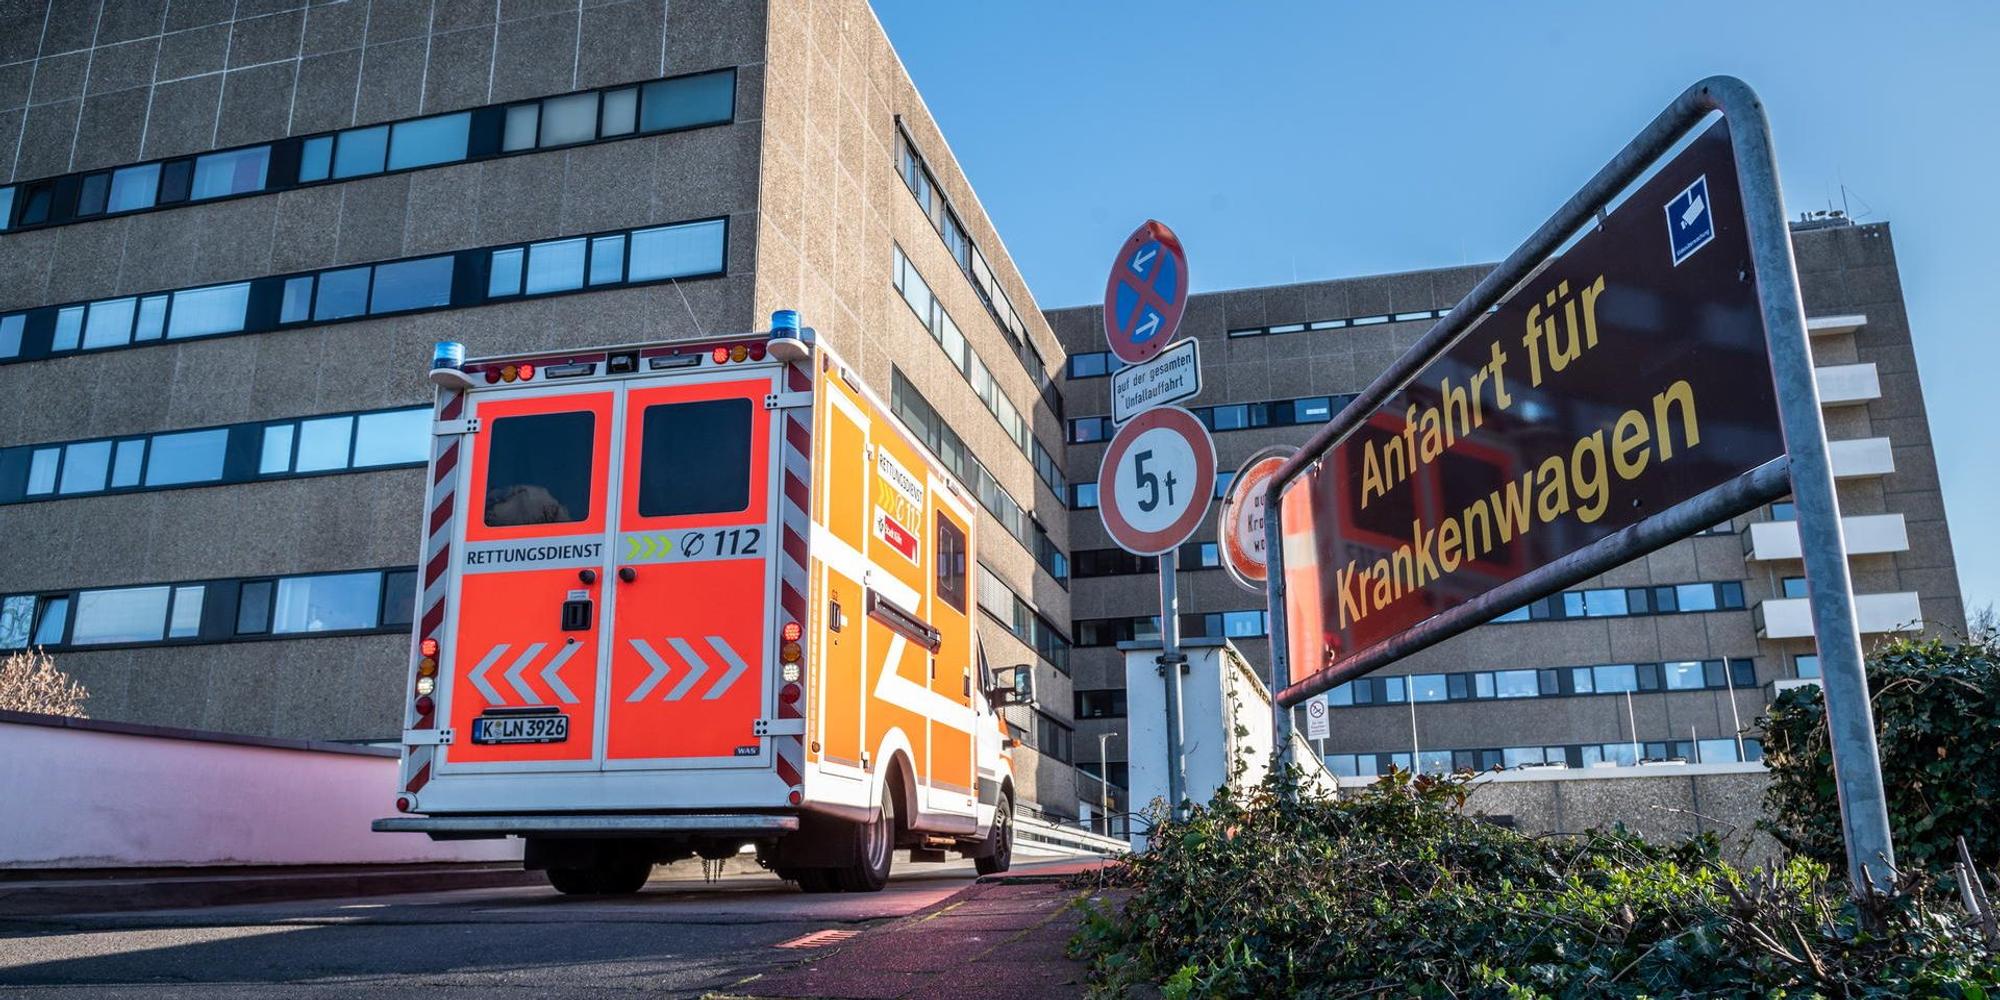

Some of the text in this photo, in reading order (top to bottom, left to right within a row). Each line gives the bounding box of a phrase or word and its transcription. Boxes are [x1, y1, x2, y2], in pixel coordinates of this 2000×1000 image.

[1116, 353, 1191, 394] auf der gesamten
[1124, 374, 1184, 410] Unfallauffahrt
[1361, 274, 1605, 510] Anfahrt für
[879, 452, 923, 504] RETTUNGSDIENST
[906, 502, 921, 537] 112
[1335, 379, 1701, 631] Krankenwagen
[466, 542, 602, 565] RETTUNGSDIENST
[713, 528, 761, 557] 112
[483, 720, 494, 738] K
[526, 719, 565, 737] 3926
